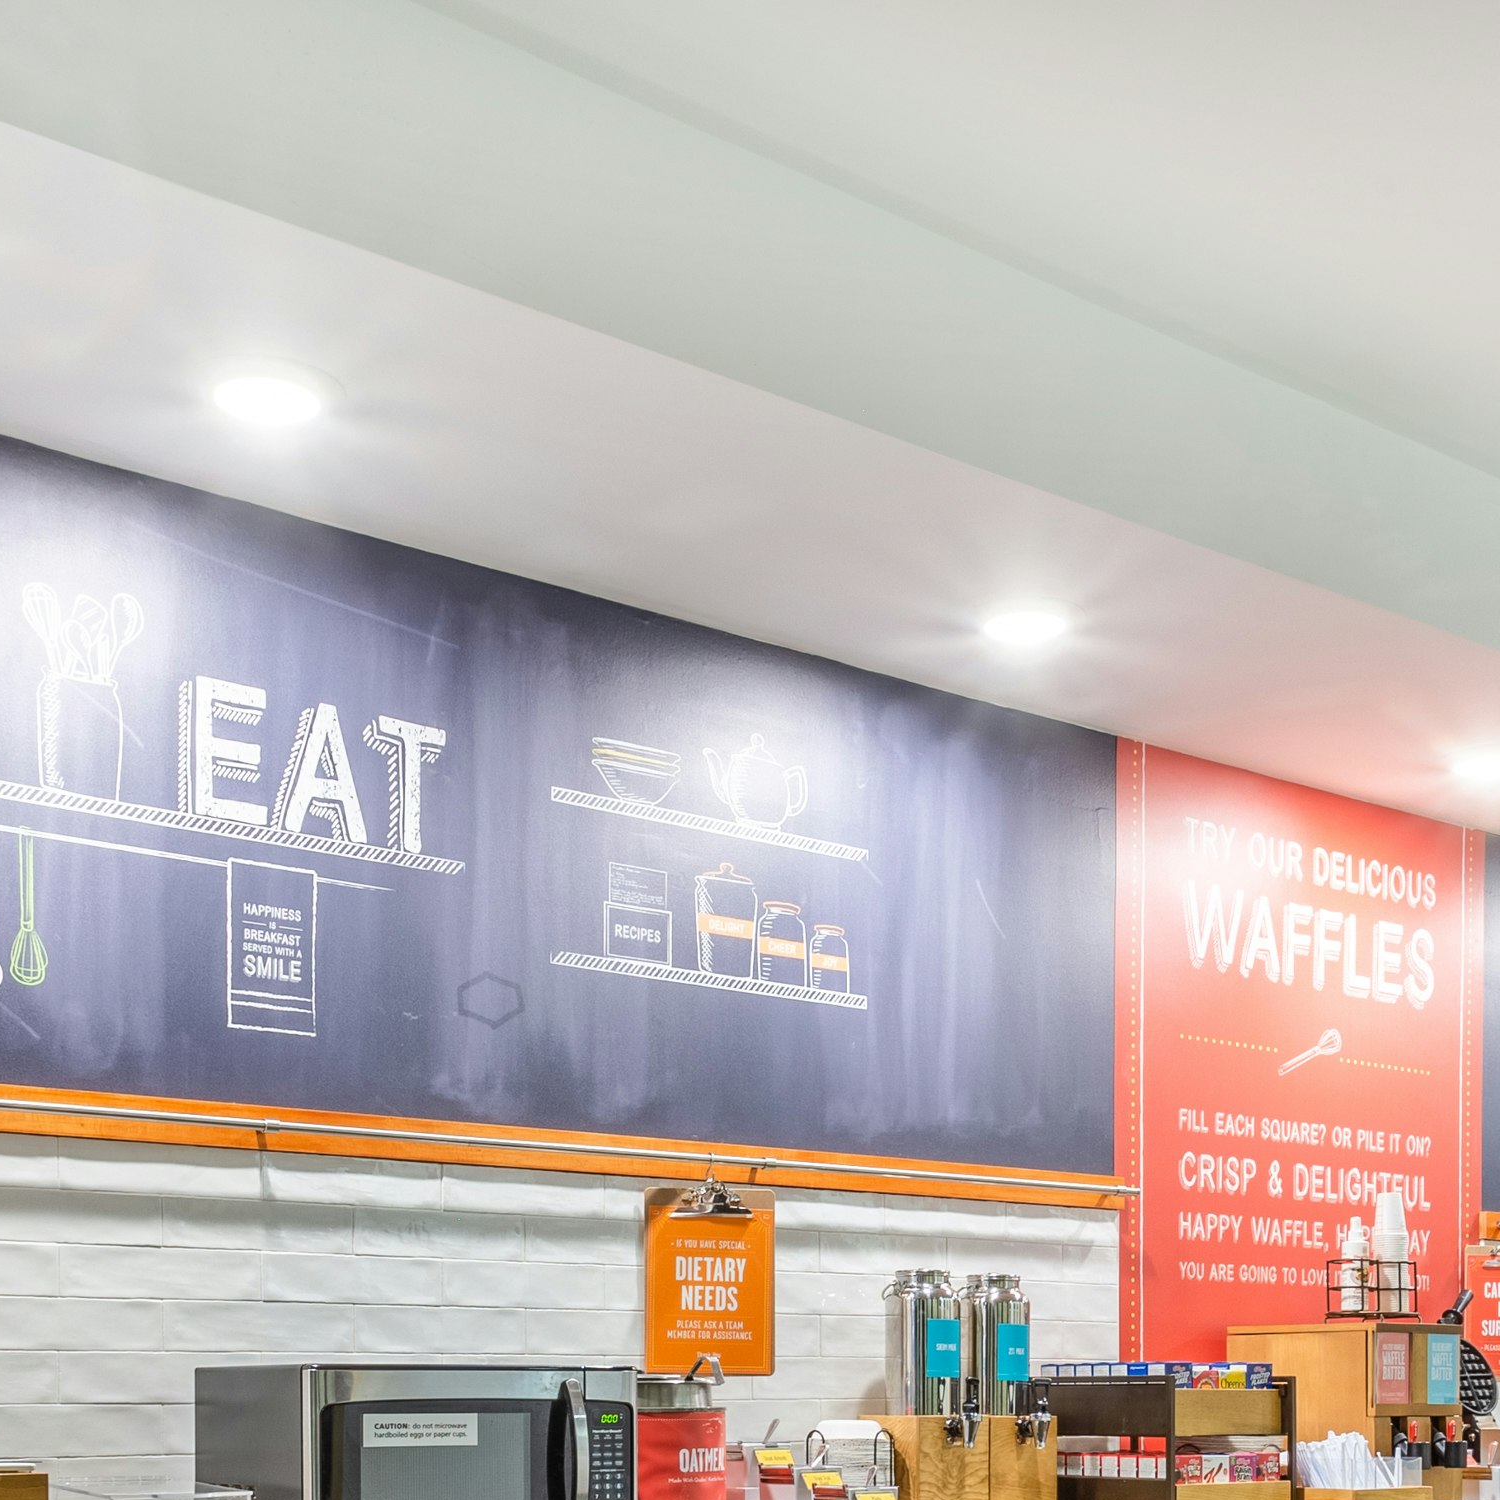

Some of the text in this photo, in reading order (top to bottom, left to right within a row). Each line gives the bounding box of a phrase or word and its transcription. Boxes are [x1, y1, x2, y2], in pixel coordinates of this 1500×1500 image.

[178, 675, 447, 854] EAT
[1183, 816, 1437, 911] TRY OUR DELICIOUS
[243, 902, 302, 922] HAPPINESS
[268, 921, 277, 930] IS
[614, 923, 662, 944] RECIPES
[708, 918, 745, 934] DELIGHT
[244, 928, 301, 948] BREAKFAST
[1181, 878, 1436, 1010] WAFFLES
[243, 942, 303, 958] SERVED WITH A
[768, 942, 796, 955] CHEER
[243, 954, 302, 982] SMILE
[822, 956, 838, 969] JOY
[1179, 1108, 1431, 1158] FILL EACH SQUARE? OR PILE IT ON?
[1179, 1151, 1431, 1212] CRISP & DELIGHTFUL
[1179, 1211, 1243, 1243] HAPPY
[1251, 1217, 1329, 1253] WAFFLE,
[684, 1239, 698, 1248] YOU
[700, 1240, 717, 1249] HAVE
[719, 1240, 746, 1250] SPECIAL
[675, 1256, 746, 1283] DIETARY
[1179, 1261, 1205, 1281] YOU
[1209, 1263, 1235, 1283] ARE
[1239, 1265, 1278, 1285] GOING
[1282, 1267, 1298, 1286] TO
[1301, 1268, 1329, 1288] LOVE
[681, 1285, 738, 1311] NEEDS
[676, 1319, 744, 1329] PLEASE ASK A TEAM
[667, 1329, 753, 1341] MEMBER FOR ASSISTANCE
[1382, 1351, 1405, 1366] WAFFLE
[1432, 1352, 1452, 1366] WAFFLE
[1383, 1366, 1405, 1380] BATTER
[1431, 1367, 1452, 1381] BATTER
